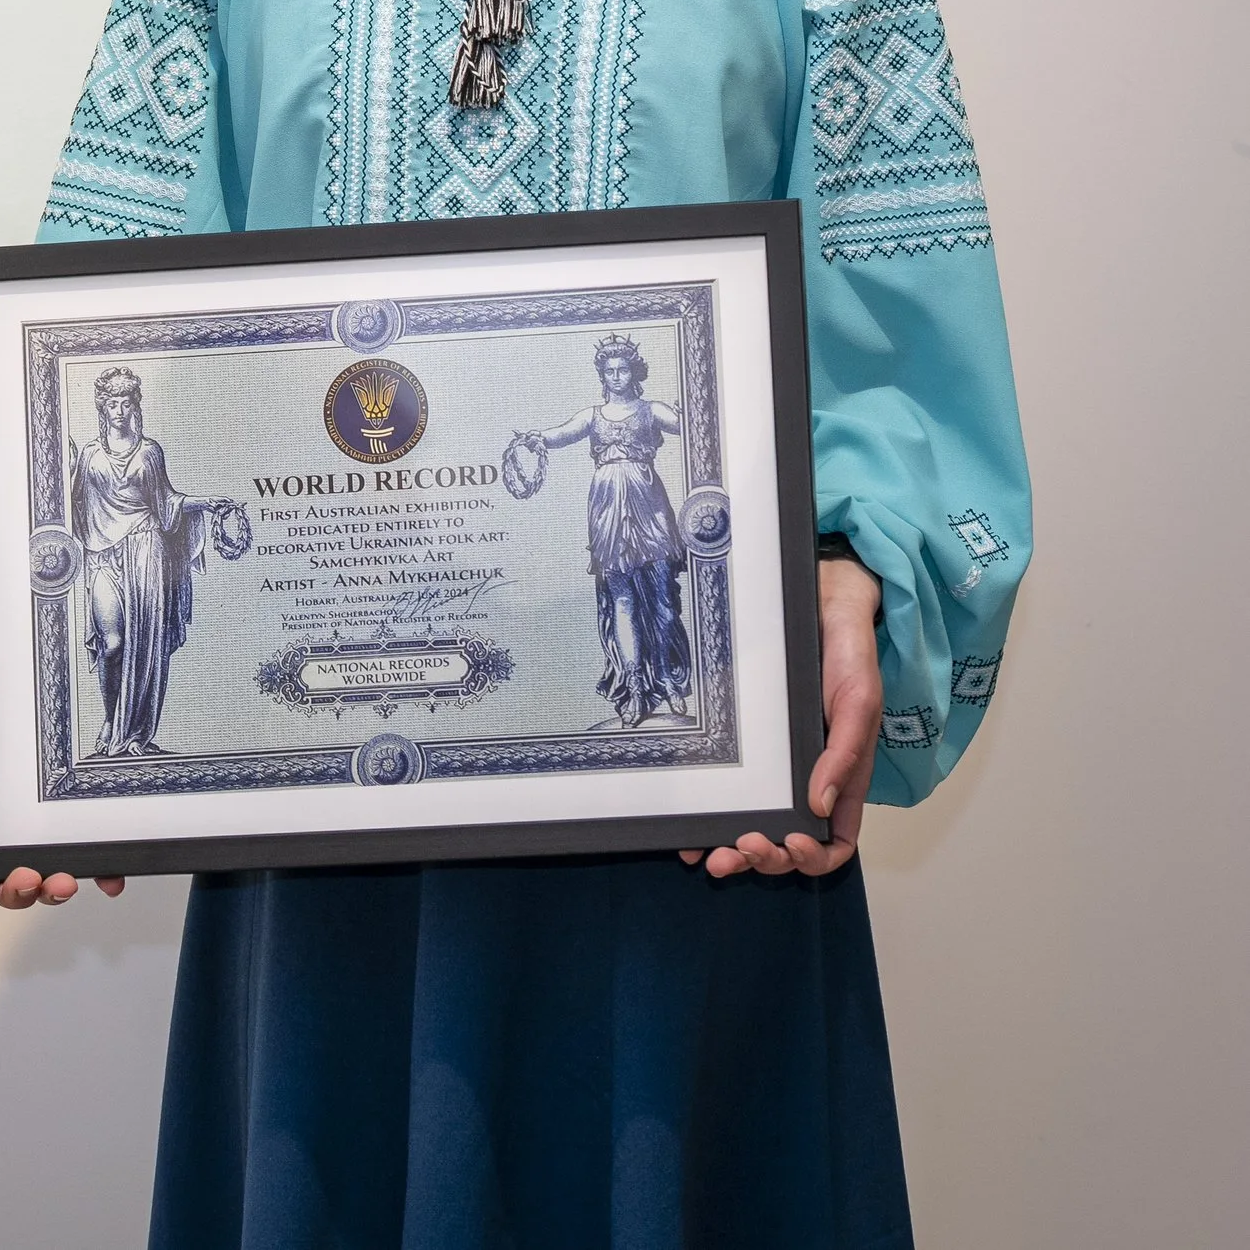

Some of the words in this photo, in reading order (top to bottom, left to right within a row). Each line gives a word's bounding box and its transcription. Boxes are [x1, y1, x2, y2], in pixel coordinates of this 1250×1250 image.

[325, 369, 351, 409] NATIONAL
[350, 360, 389, 372] REGISTER
[390, 362, 401, 371] OF
[401, 369, 426, 403] RECORDS
[253, 472, 365, 498] WORLD
[374, 464, 498, 492] RECORD
[260, 508, 300, 522] FIRST
[305, 504, 400, 519] AUSTRALIAN
[288, 523, 370, 537] DEDICATED
[376, 519, 441, 533] ENTIRELY
[444, 517, 464, 528] TO
[257, 541, 345, 556] DECORATIVE
[350, 536, 434, 551] UKRAINIAN
[438, 534, 473, 545] FOLK
[478, 531, 510, 543] ART:
[309, 553, 418, 570] SAMCHYKIVKA
[423, 550, 454, 563] ART
[260, 578, 317, 593] ARTIST
[333, 574, 383, 588] ANNA
[389, 567, 504, 585] MYKHALCHUK
[444, 588, 468, 598] 2024
[317, 661, 385, 674] NATIONAL
[389, 657, 450, 671] RECORDS
[342, 671, 427, 685] WORLDWIDE
